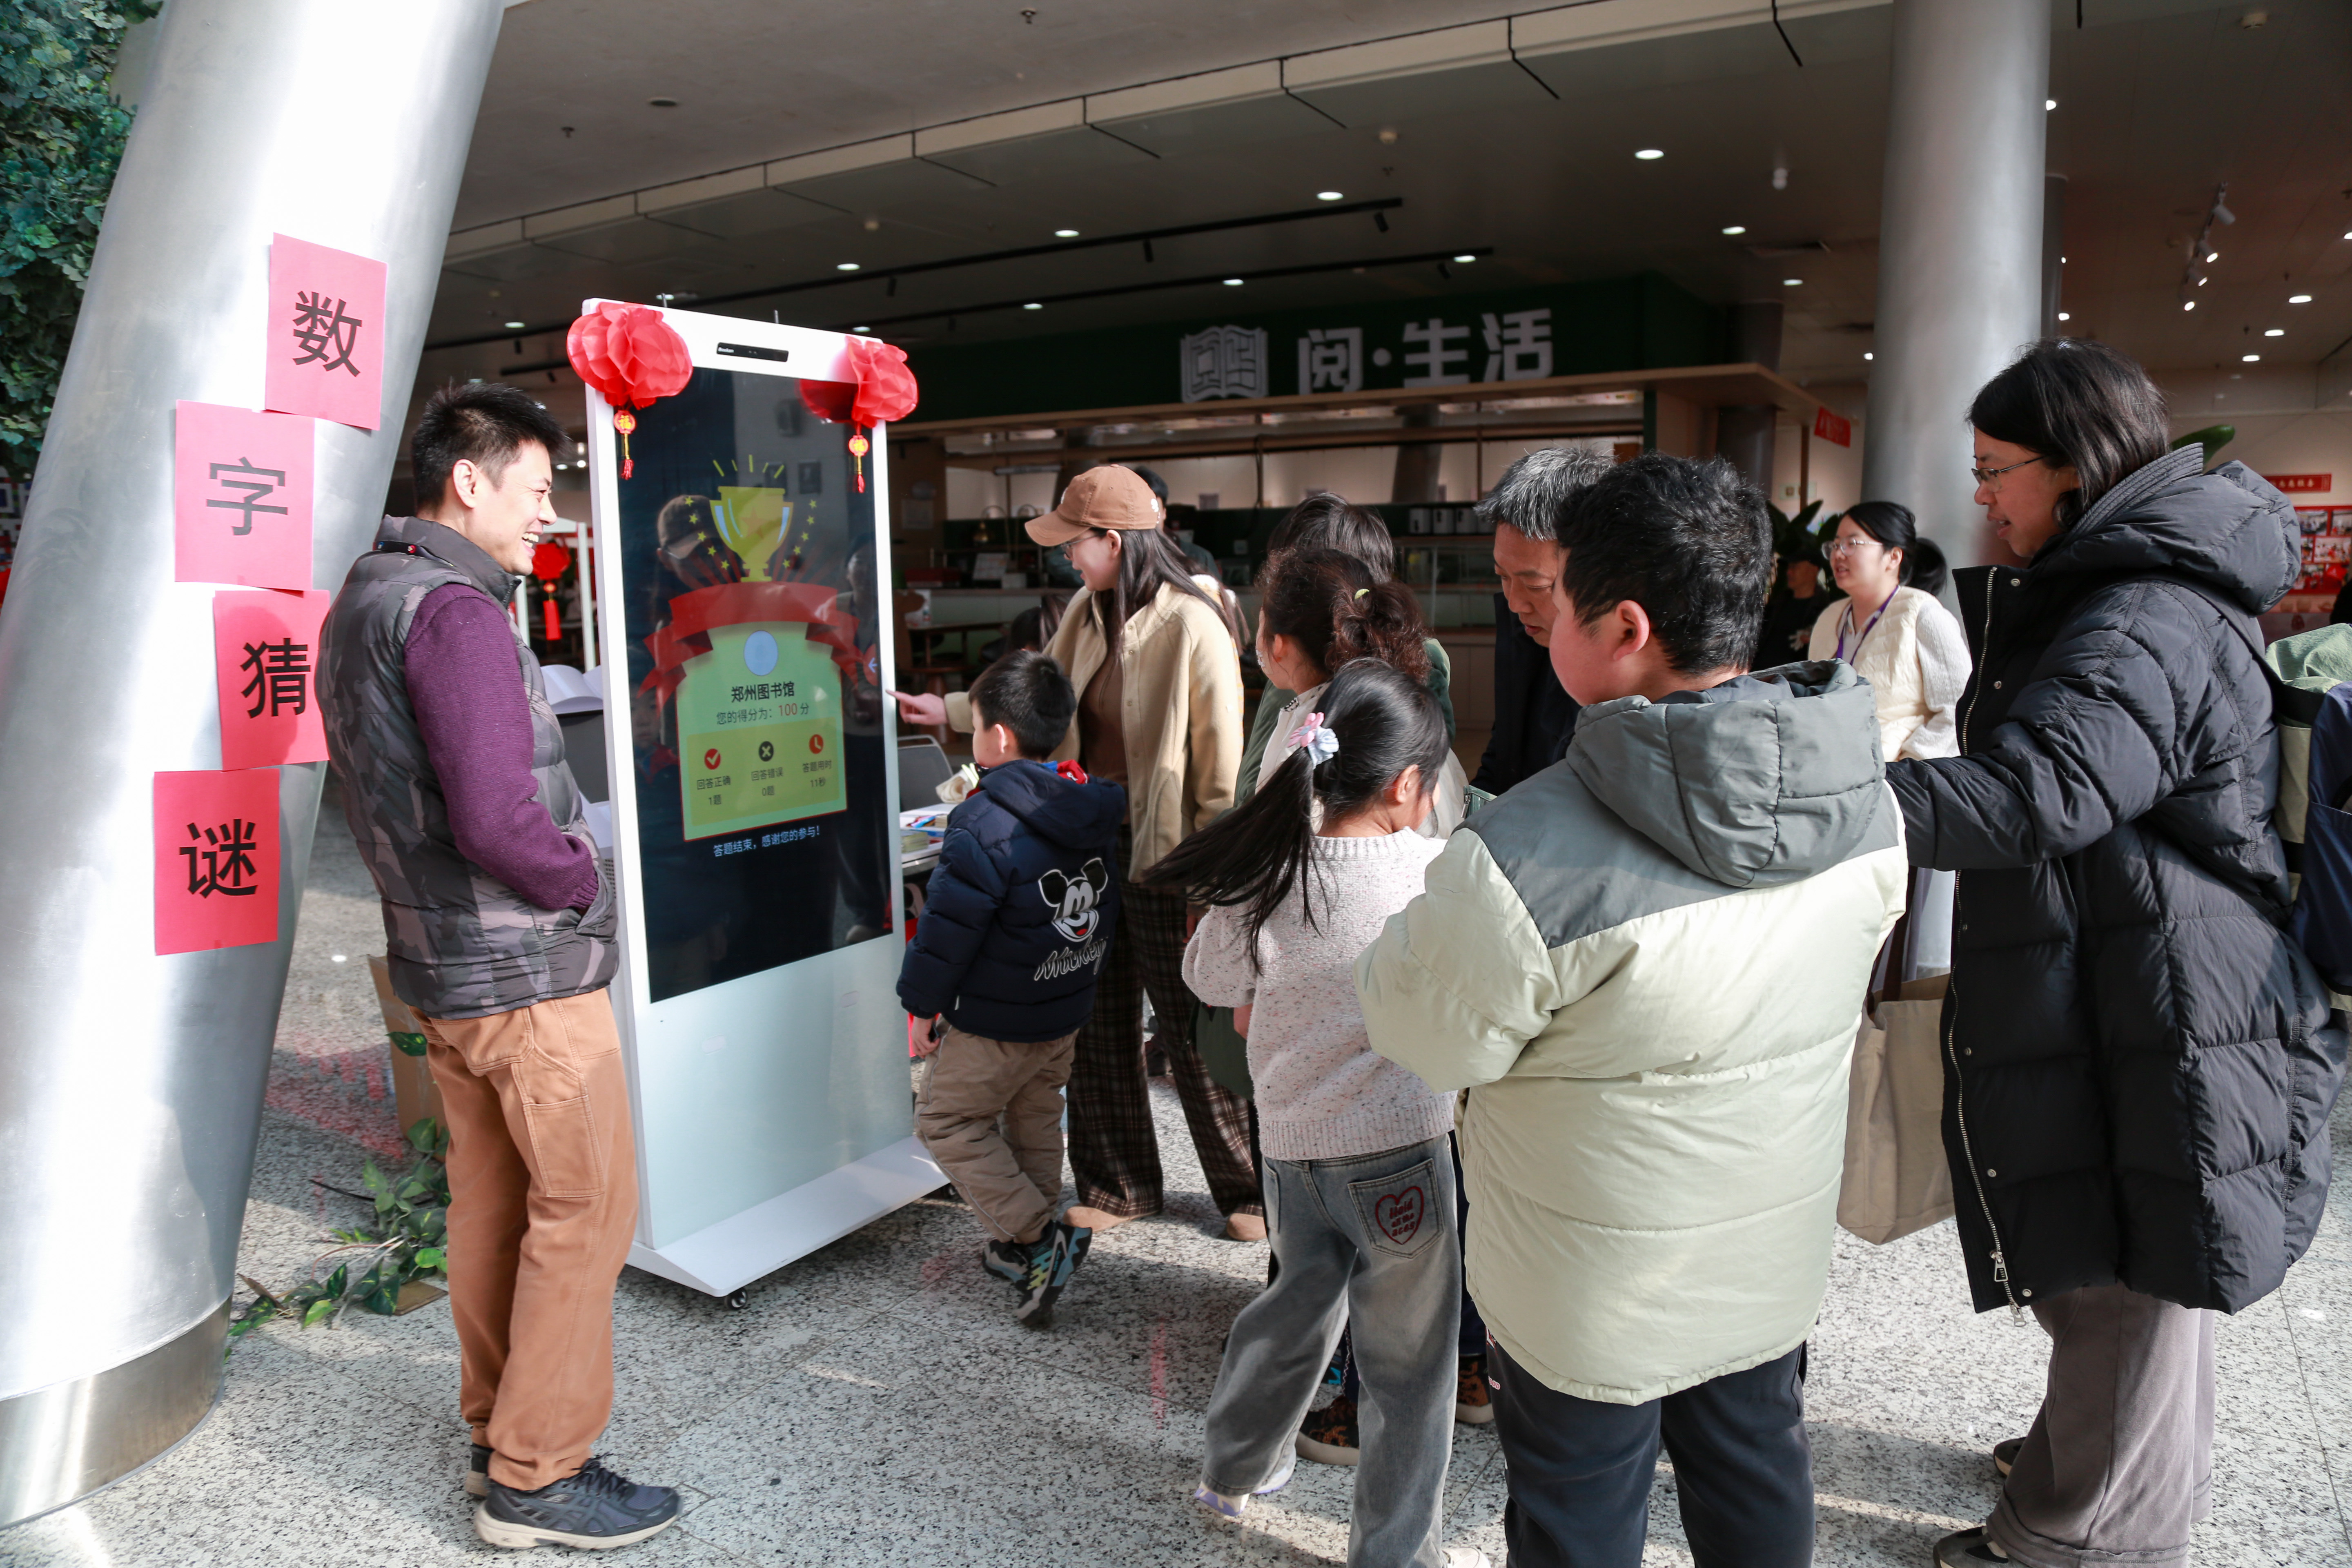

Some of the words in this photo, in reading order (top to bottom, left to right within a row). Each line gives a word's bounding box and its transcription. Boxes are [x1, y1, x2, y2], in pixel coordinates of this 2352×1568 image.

[292, 290, 363, 376] 数
[205, 457, 288, 536] 字
[240, 637, 311, 719] 猜
[731, 681, 795, 703] 郑州图书馆
[778, 703, 798, 717] 100
[800, 703, 809, 715] 分
[802, 759, 832, 773] 答题用时
[751, 767, 783, 781] 回答错误
[697, 776, 731, 790] 回答正确
[810, 777, 826, 788] 11秒
[762, 785, 775, 796] 0题
[708, 794, 722, 805] 1题
[179, 818, 257, 897] 谜
